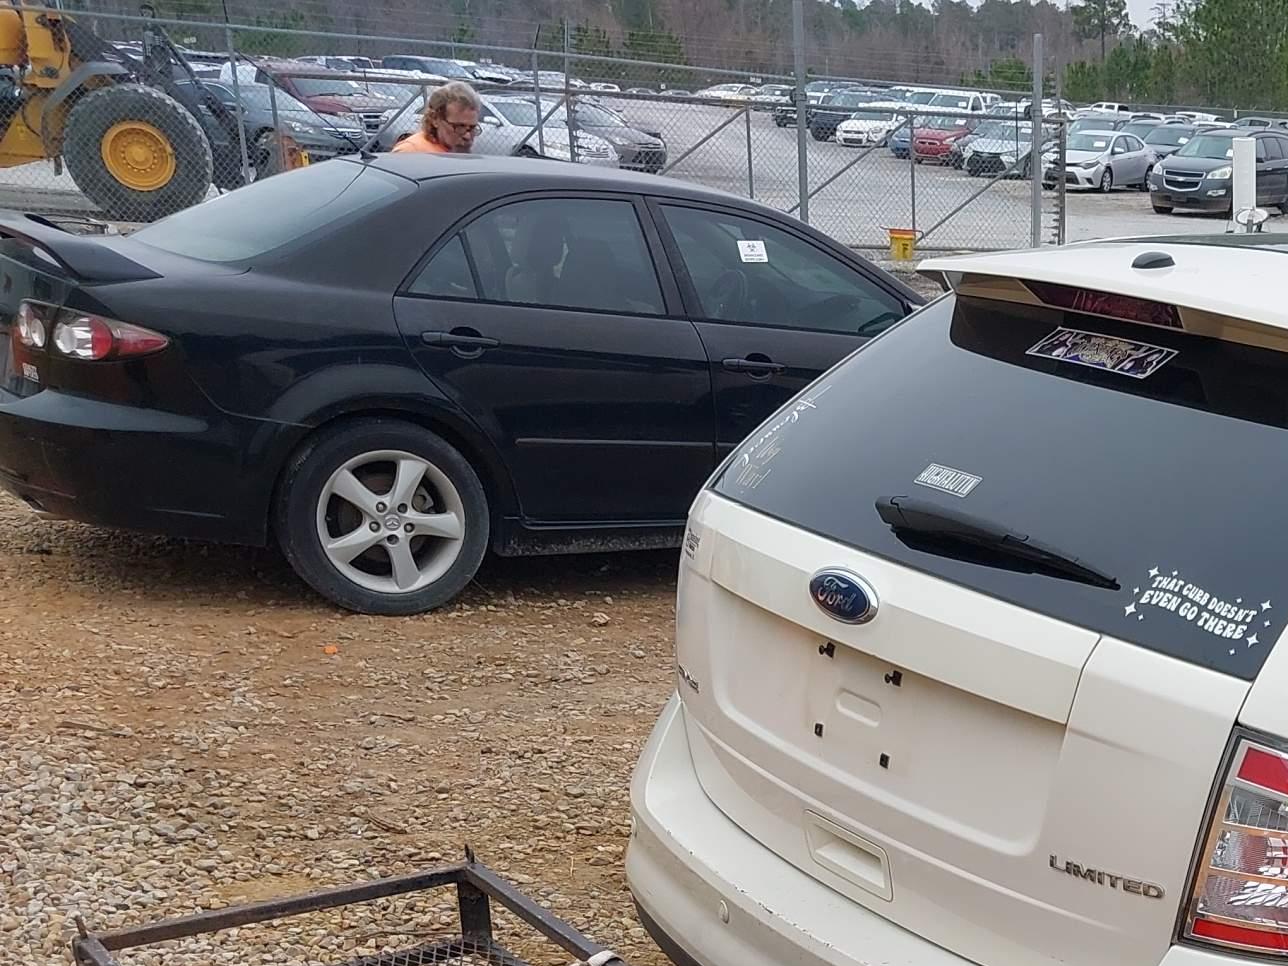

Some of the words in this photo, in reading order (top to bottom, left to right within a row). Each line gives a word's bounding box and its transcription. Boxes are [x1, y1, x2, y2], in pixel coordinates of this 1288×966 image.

[817, 576, 857, 611] Ford
[1139, 589, 1182, 612] EVEN
[1178, 602, 1198, 621] GO
[1196, 612, 1248, 640] THERE
[1151, 576, 1185, 593] THAT
[1181, 583, 1211, 606] CURB
[1207, 597, 1257, 623] DOESN'T
[1049, 854, 1166, 899] LIMITED
